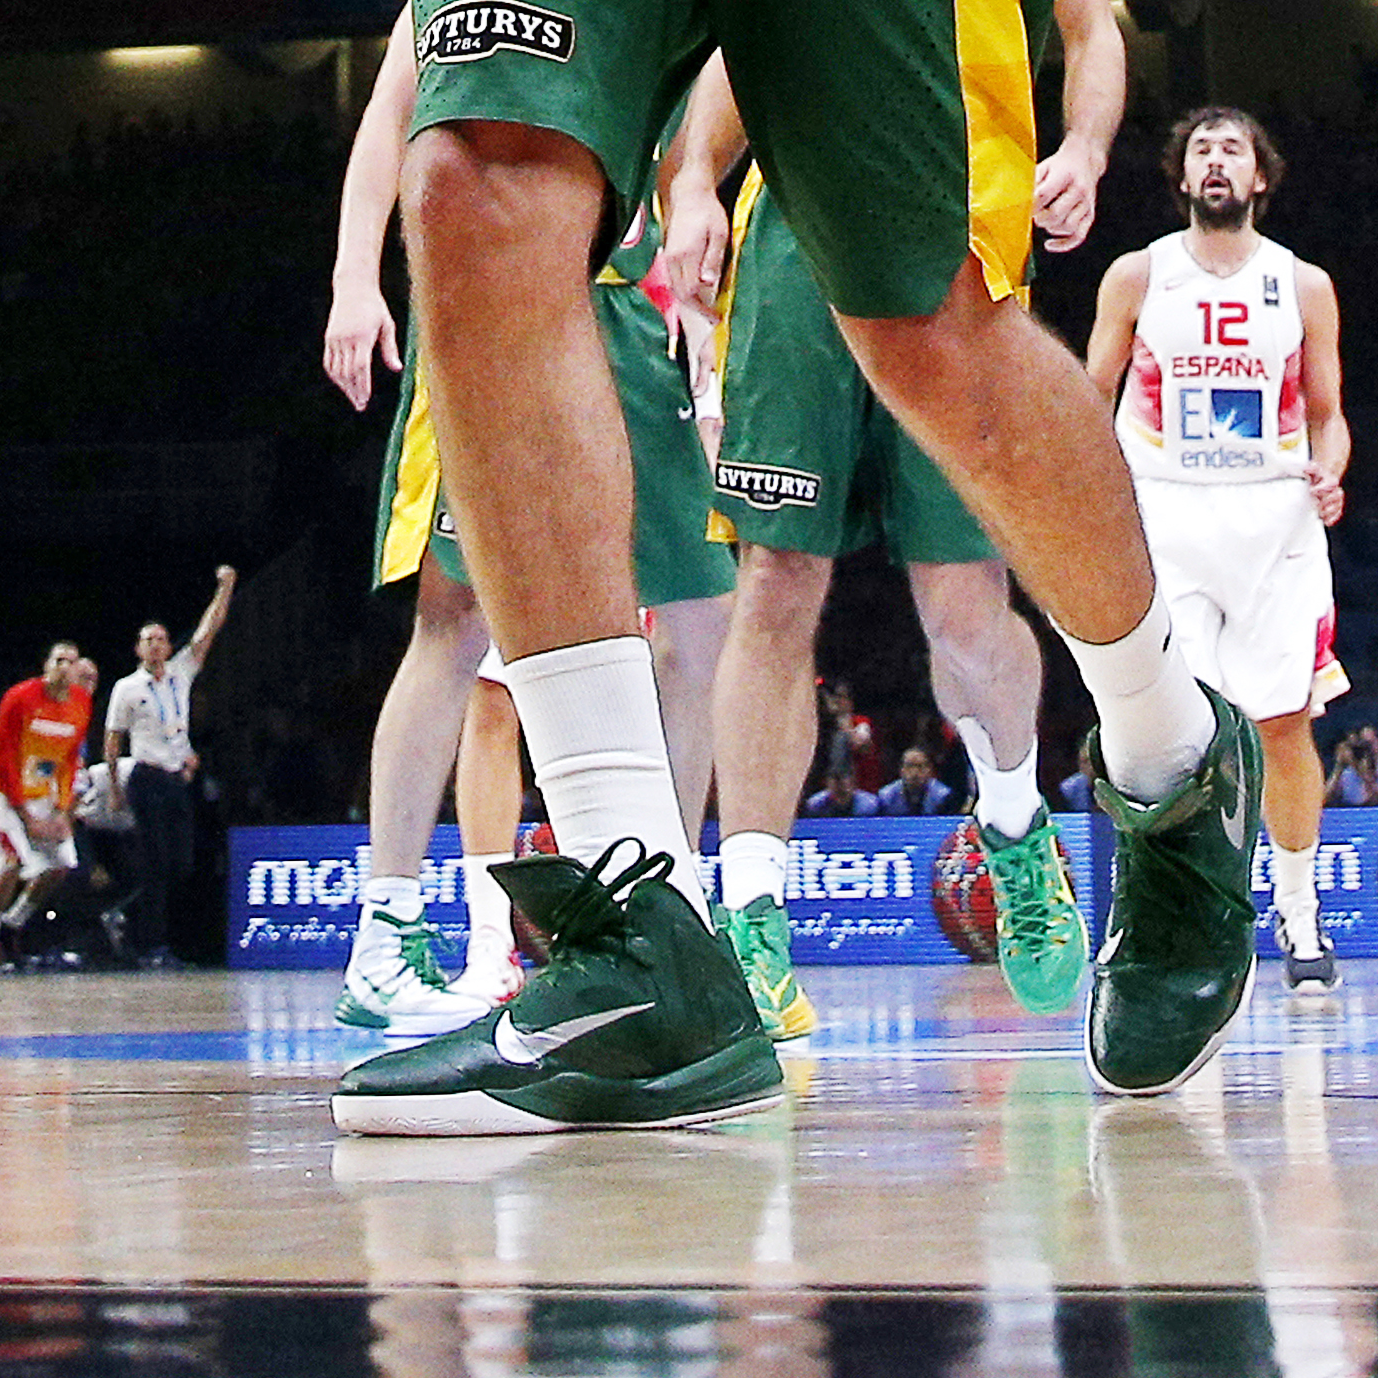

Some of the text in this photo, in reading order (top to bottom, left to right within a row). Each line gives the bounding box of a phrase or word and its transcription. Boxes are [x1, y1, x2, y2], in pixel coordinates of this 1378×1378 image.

[445, 37, 482, 53] 1784
[1197, 301, 1250, 346] 12
[1172, 351, 1270, 380] ESPAÑA
[1180, 446, 1265, 469] endesa
